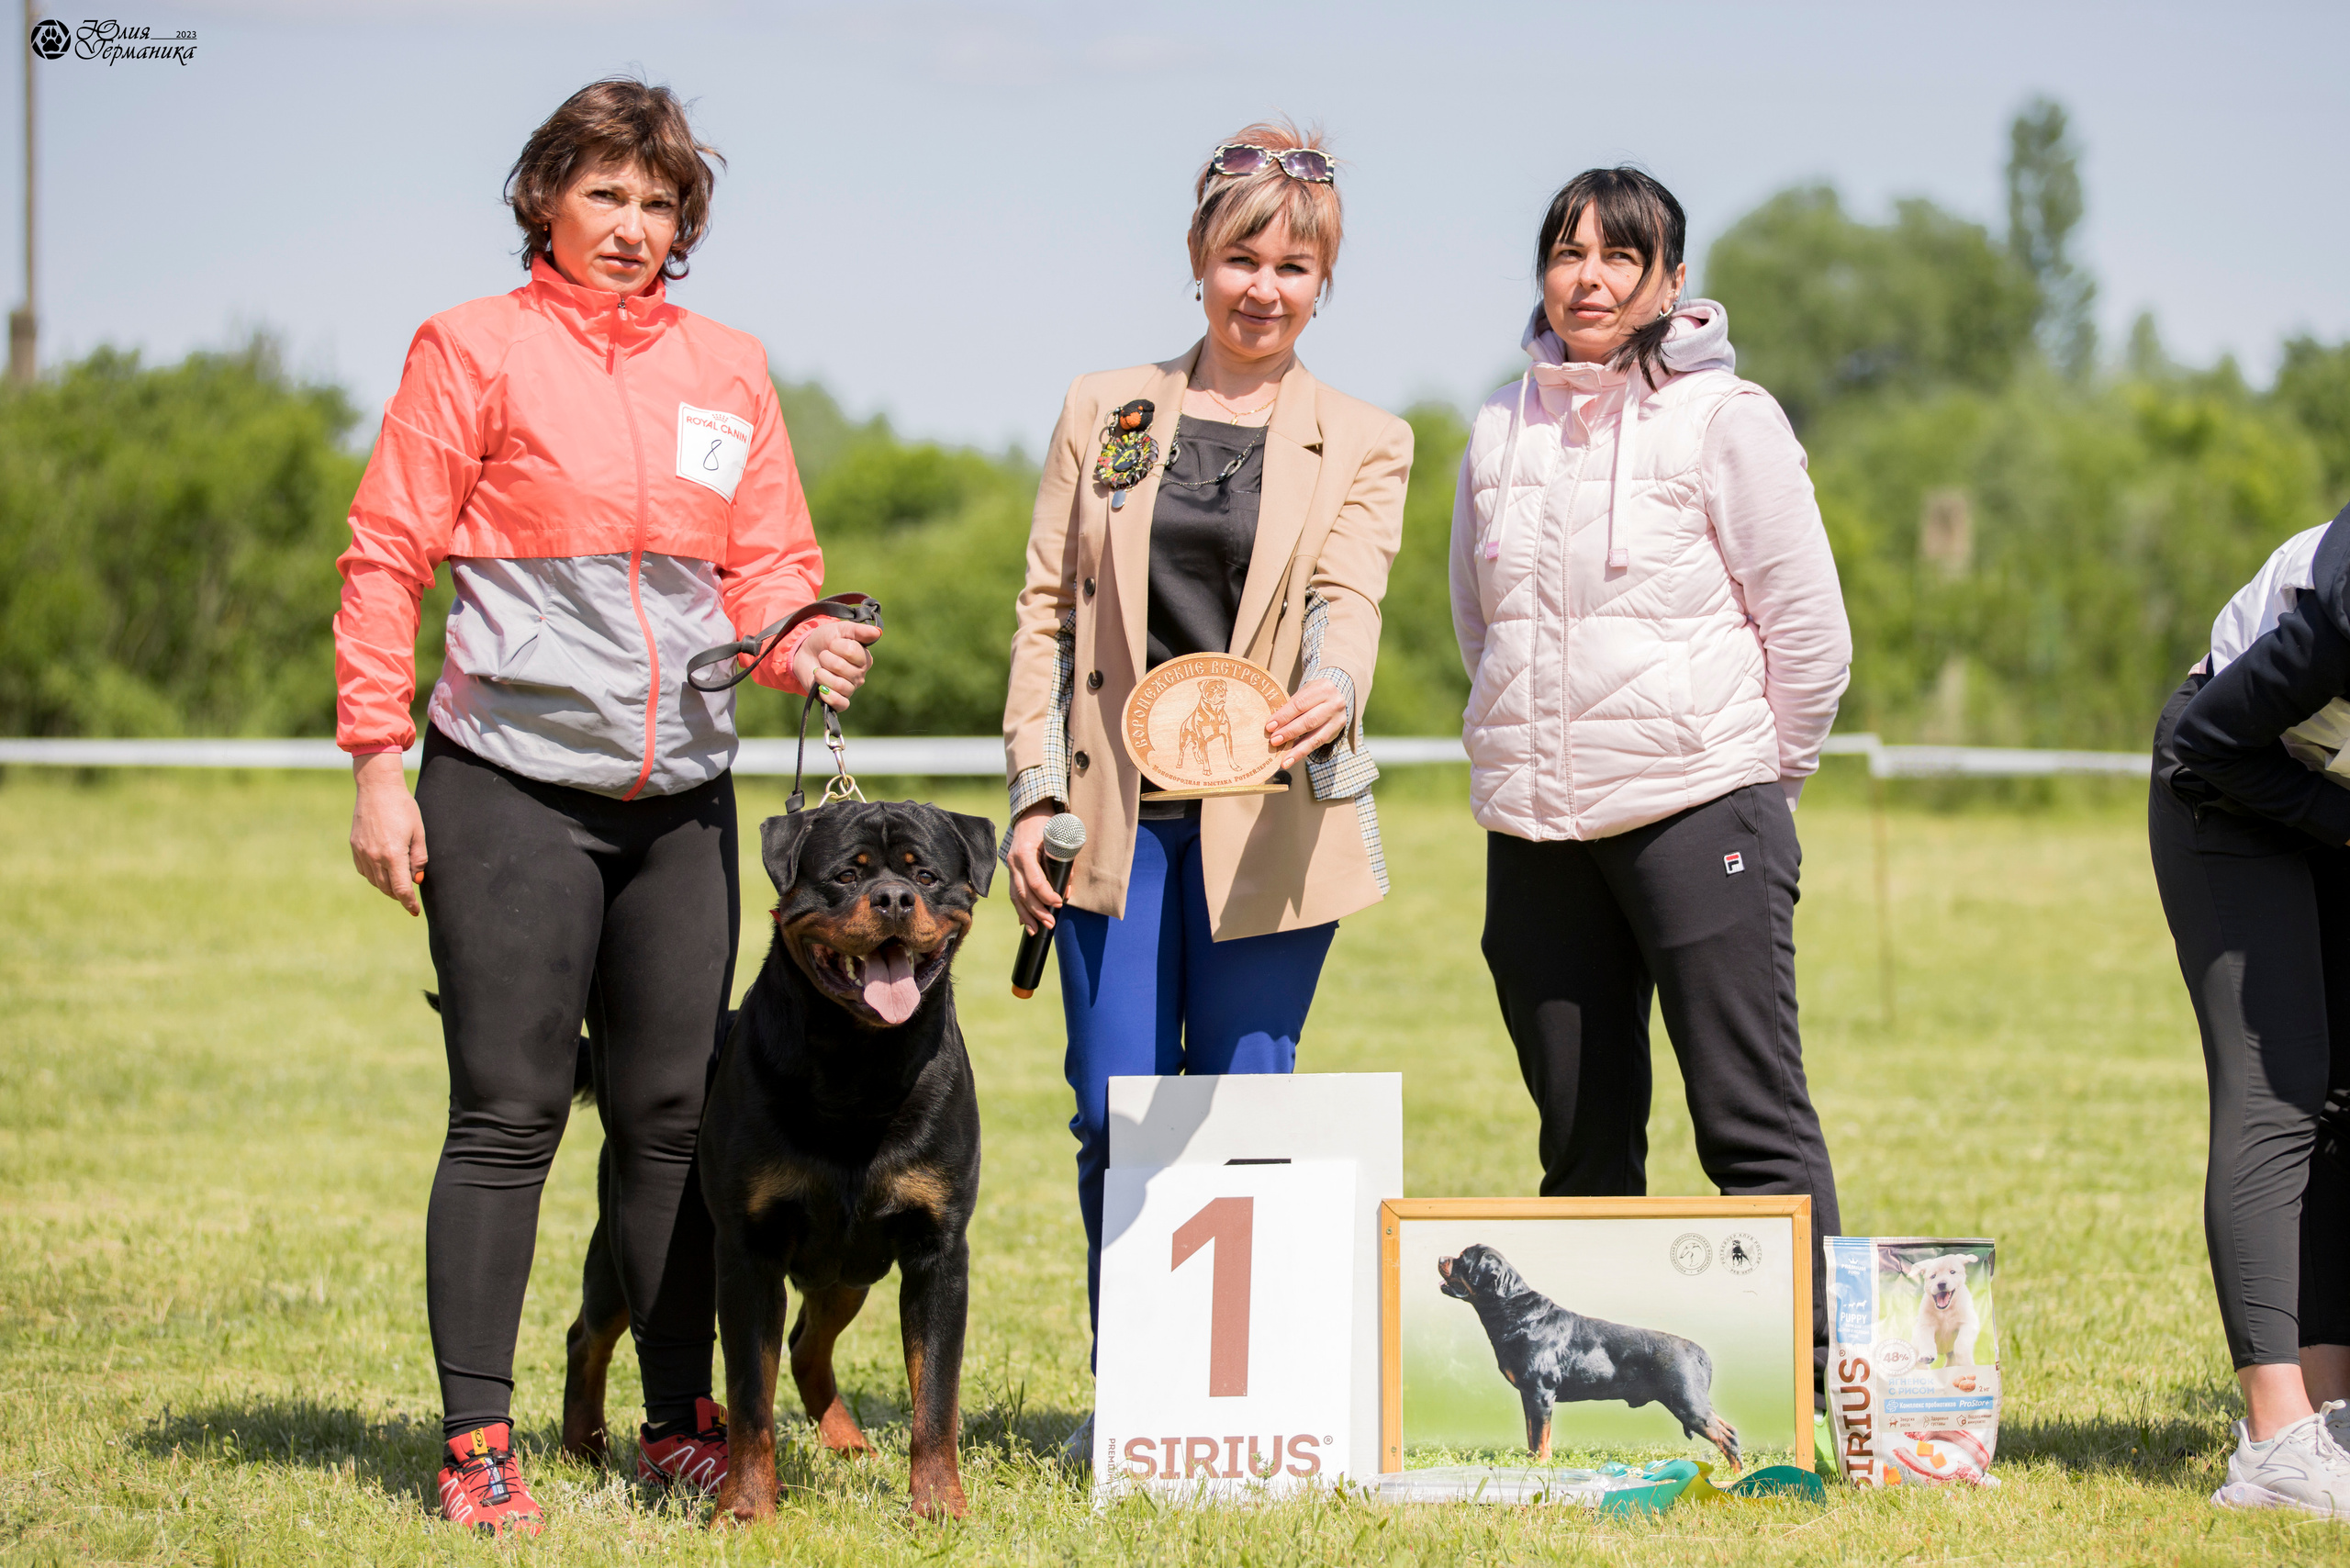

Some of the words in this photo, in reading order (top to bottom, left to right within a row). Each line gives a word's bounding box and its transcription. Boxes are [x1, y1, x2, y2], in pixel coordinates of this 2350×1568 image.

[686, 415, 719, 431] ROYAL
[720, 424, 748, 444] CANIN
[702, 439, 722, 472] 8
[1211, 660, 1279, 702] ВСТРЕЧИ
[1841, 1263, 1867, 1272] PREMIUM
[1170, 1196, 1255, 1397] 1
[1840, 1311, 1868, 1325] PUPPY
[1882, 1351, 1909, 1363] 48%
[1888, 1386, 1897, 1395] С
[1898, 1386, 1935, 1395] РИСОМ
[1899, 1401, 1925, 1409] Комплекс
[1925, 1401, 1957, 1410] пробиотиков
